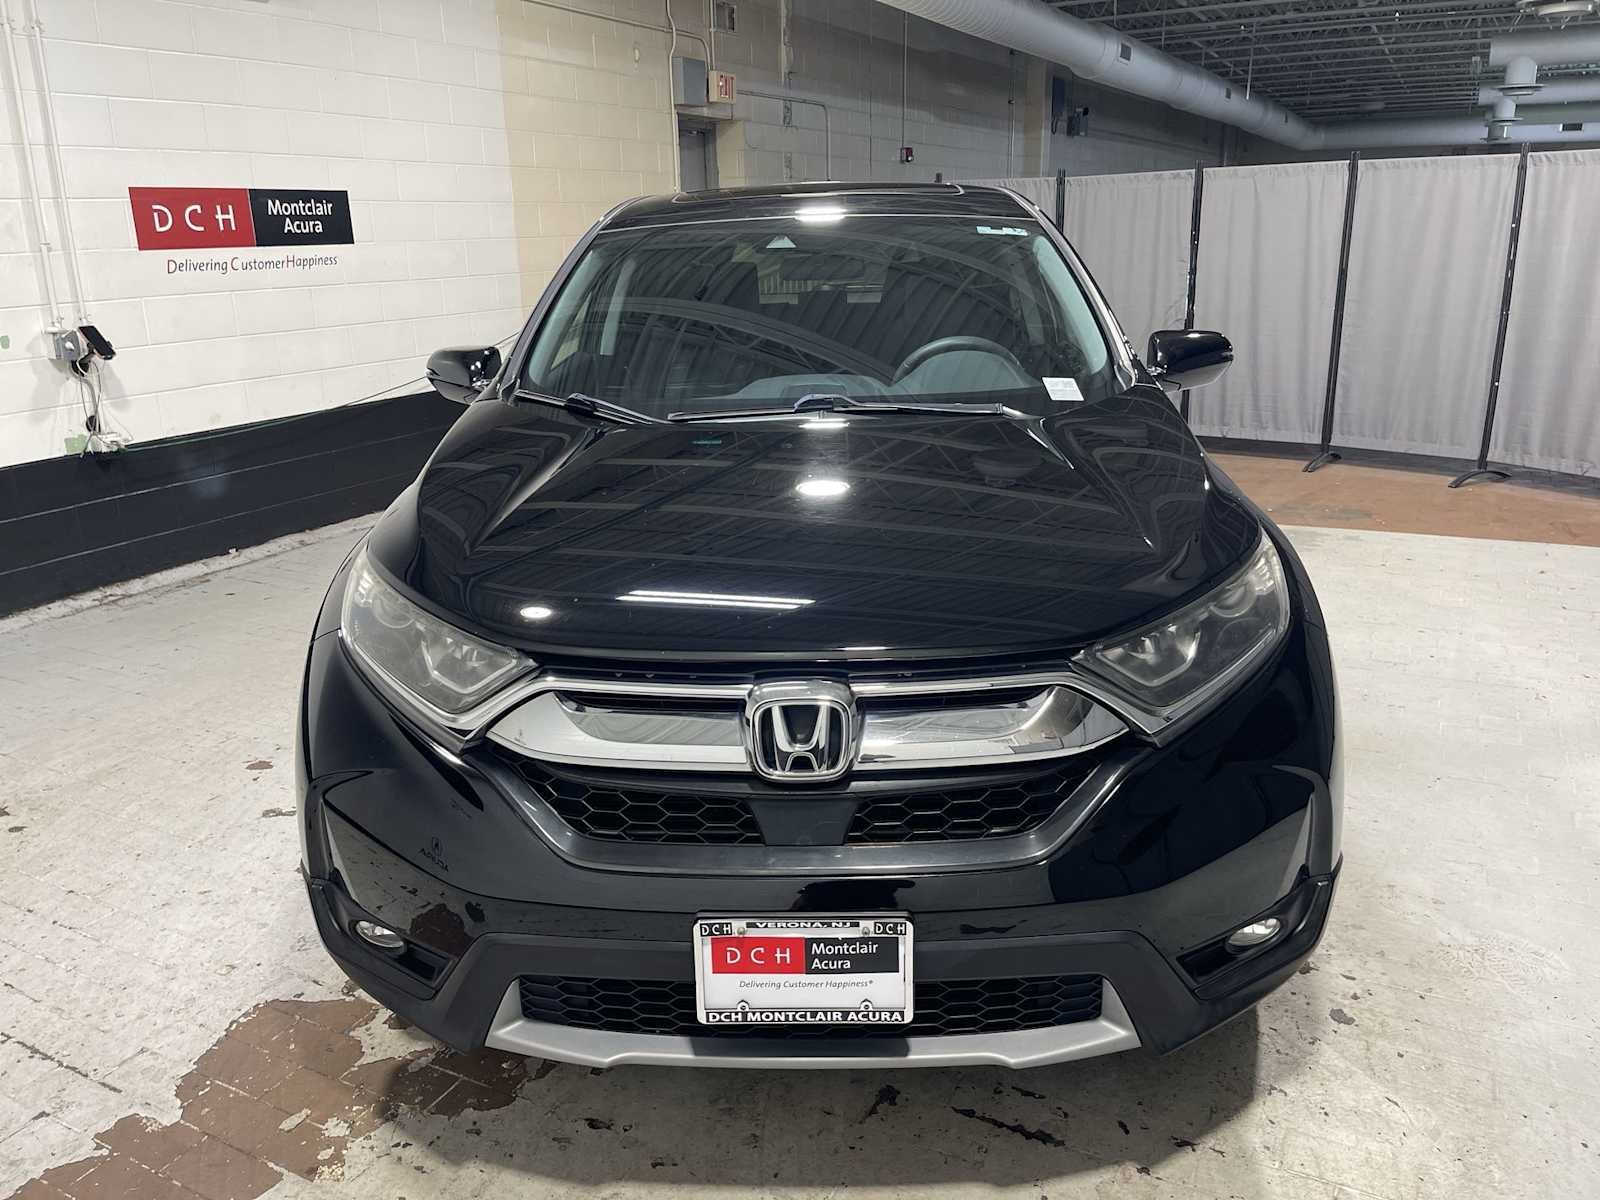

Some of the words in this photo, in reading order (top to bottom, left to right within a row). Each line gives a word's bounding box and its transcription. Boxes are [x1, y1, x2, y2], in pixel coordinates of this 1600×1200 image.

[267, 199, 333, 216] Montclair
[152, 204, 236, 232] DCH
[284, 218, 323, 233] Acura
[167, 258, 228, 274] Delivering
[231, 257, 285, 271] Customer
[286, 254, 338, 269] Happiness
[701, 925, 732, 935] DCH
[875, 924, 906, 934] DCH
[811, 942, 878, 954] Montclair
[726, 947, 790, 964] DCH
[811, 958, 851, 970] Acura
[739, 980, 781, 989] Delivering
[783, 980, 823, 988] Customer
[708, 1012, 742, 1022] DCH
[749, 1011, 843, 1022] MONTCLAIR
[847, 1011, 902, 1022] ACURA
